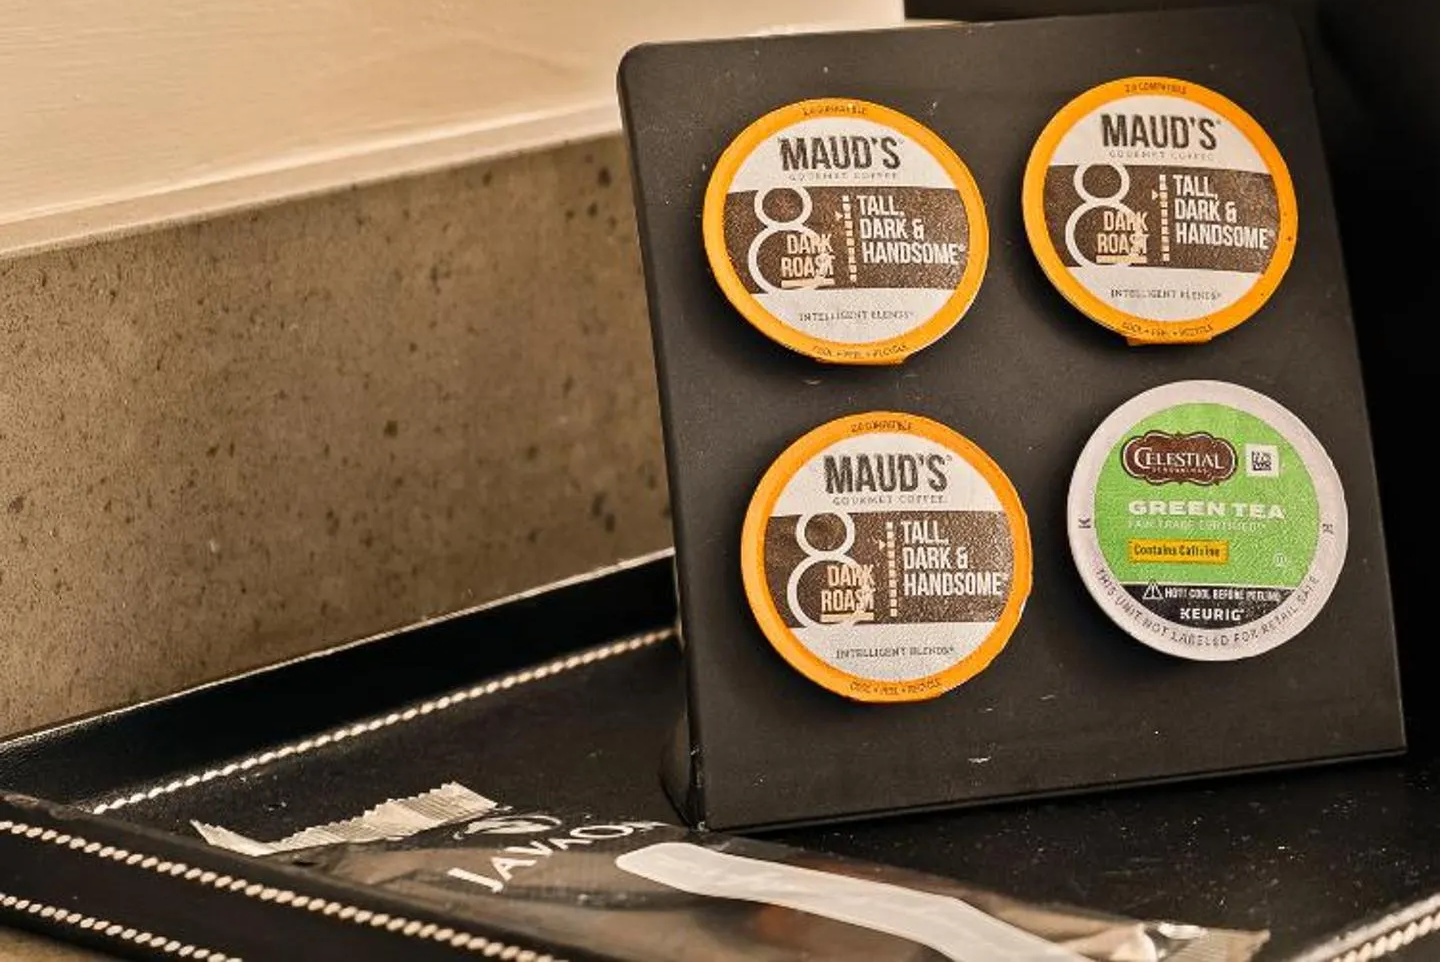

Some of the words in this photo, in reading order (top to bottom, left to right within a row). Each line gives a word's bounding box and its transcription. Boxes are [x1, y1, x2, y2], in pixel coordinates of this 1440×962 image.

[1100, 114, 1217, 150] MAUD'S
[779, 136, 901, 170] MAUD'S
[1065, 163, 1139, 270] 8
[1103, 211, 1148, 231] DARK
[1174, 198, 1219, 222] DARK
[1225, 201, 1237, 223] &
[748, 186, 824, 292] 8
[860, 218, 906, 240] DARK
[912, 218, 925, 241] &
[1175, 223, 1269, 250] HANDSOME
[786, 233, 834, 255] DARK
[862, 242, 960, 266] HANDSOME
[1097, 233, 1150, 254] ROAST
[781, 255, 835, 277] ROAST
[1134, 446, 1226, 470] CELESTIAL
[824, 453, 948, 494] MAUD'S
[1128, 500, 1225, 516] GREEN
[1231, 503, 1286, 519] TEA
[903, 547, 951, 569] DARK
[956, 546, 969, 569] &
[1134, 544, 1177, 556] Contains
[787, 511, 863, 625] 8
[827, 565, 875, 586] DARK
[904, 572, 1001, 597] HANDSOME
[821, 589, 875, 611] ROAST
[1115, 595, 1142, 621] UNIT
[1142, 618, 1169, 637] NOT
[1234, 630, 1259, 642] FOR
[1180, 608, 1241, 621] KEURIG
